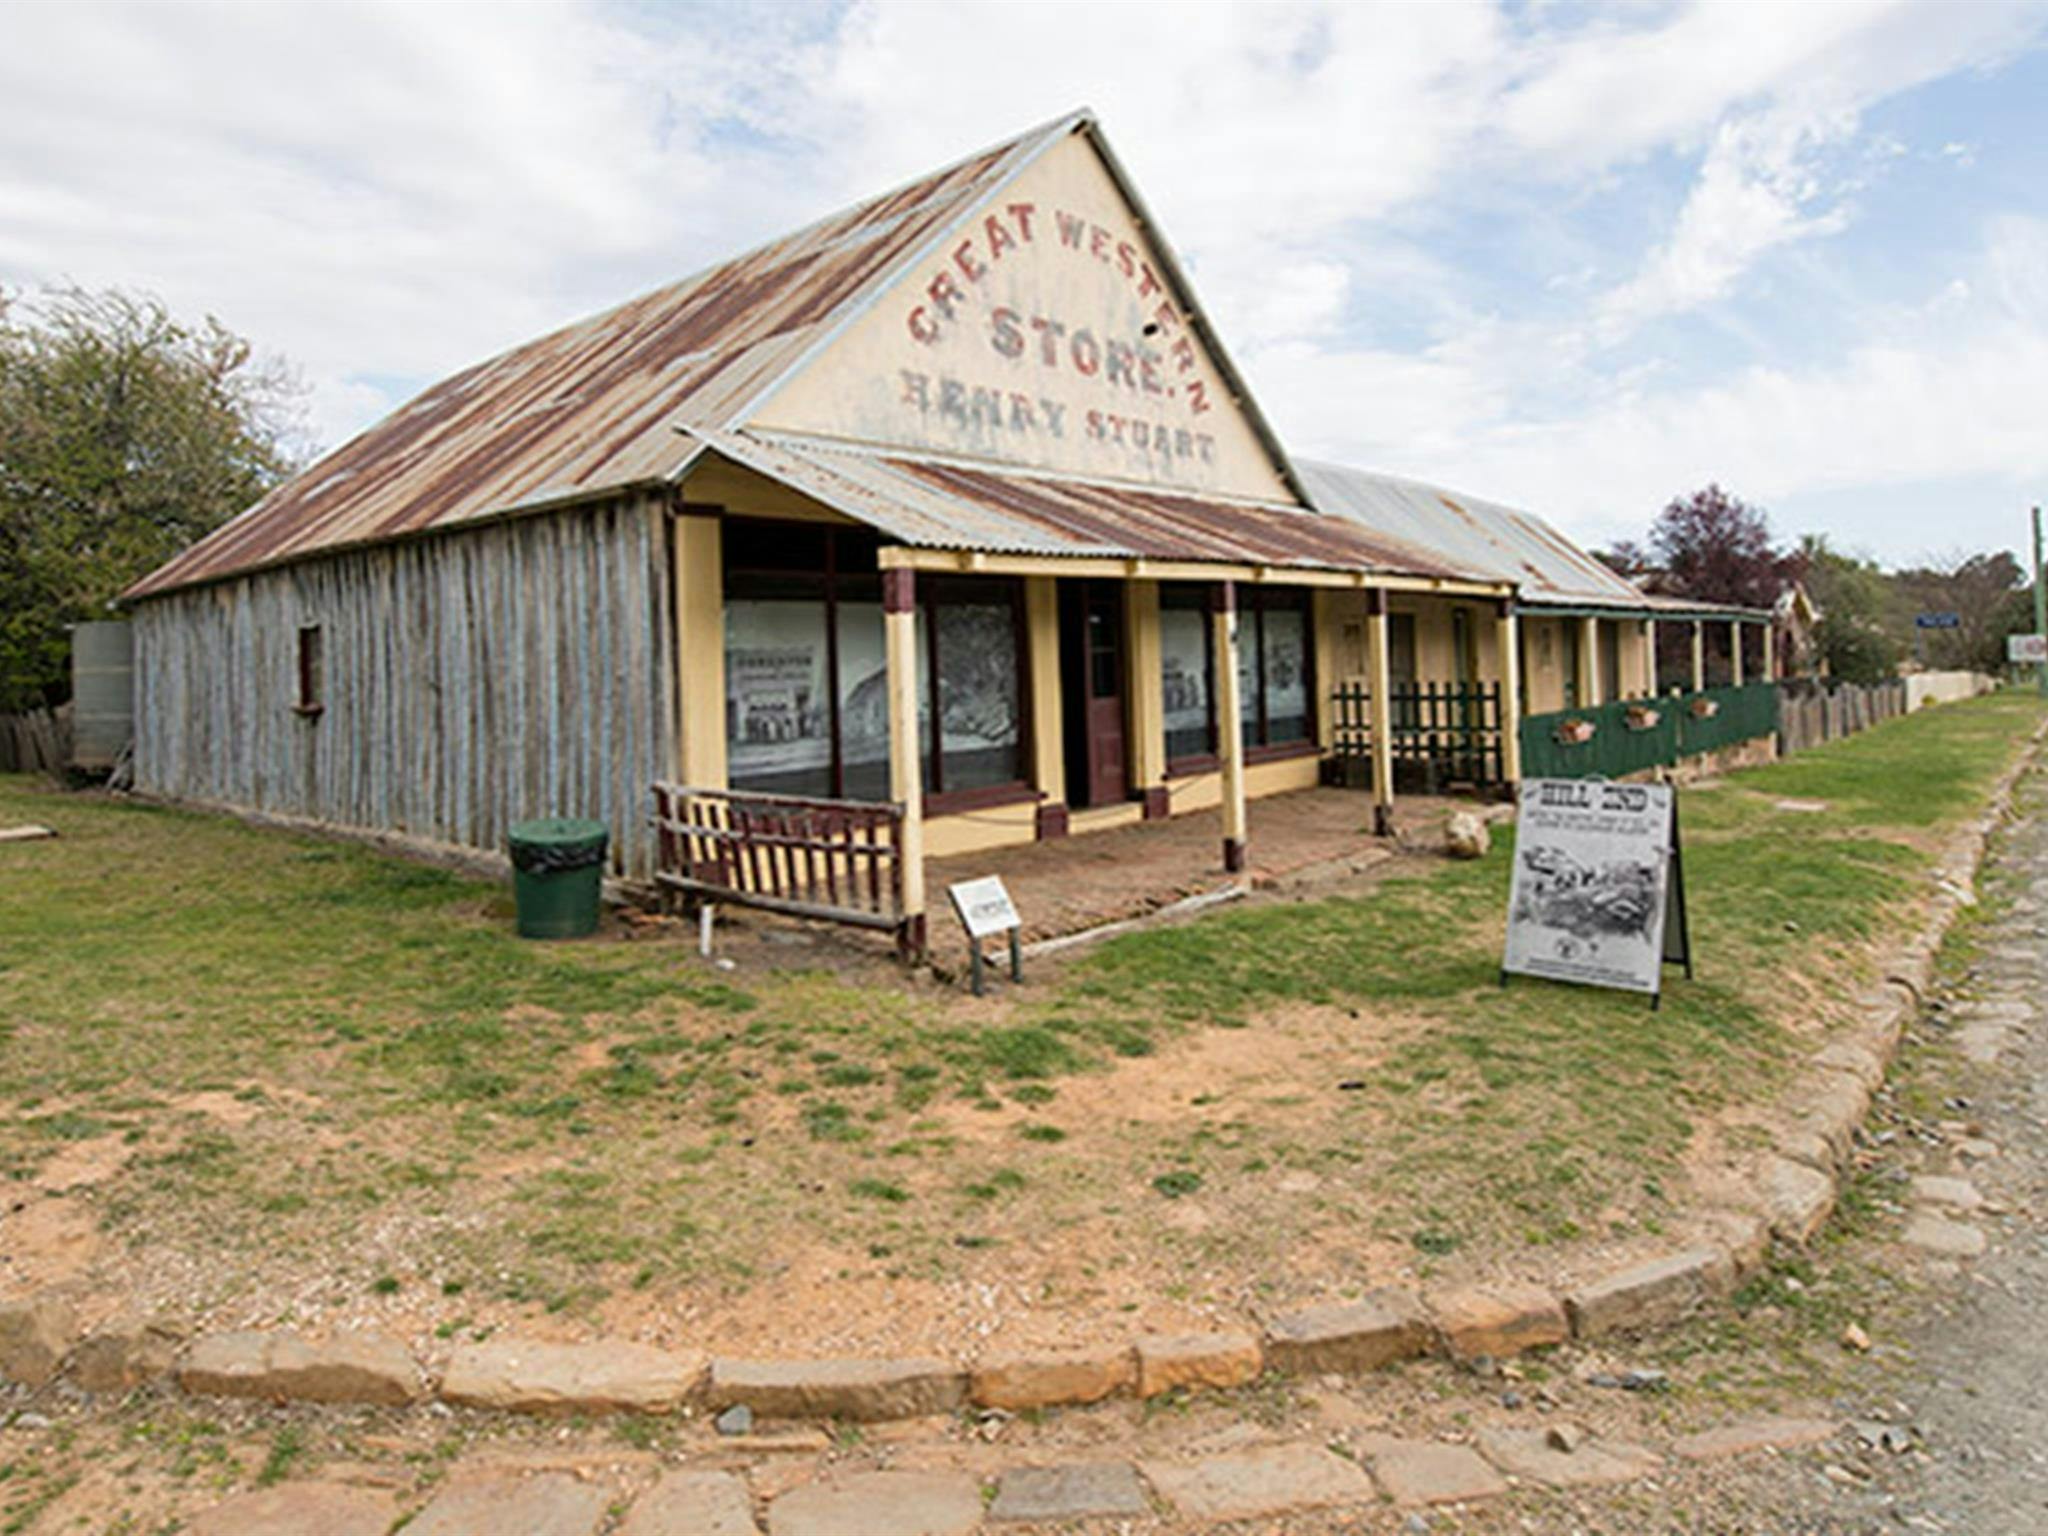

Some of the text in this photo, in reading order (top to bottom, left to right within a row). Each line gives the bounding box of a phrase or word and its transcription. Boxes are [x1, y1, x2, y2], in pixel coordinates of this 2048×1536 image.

[907, 204, 1209, 414] GREAT WESTERN
[901, 369, 1214, 461] HENRY STUART
